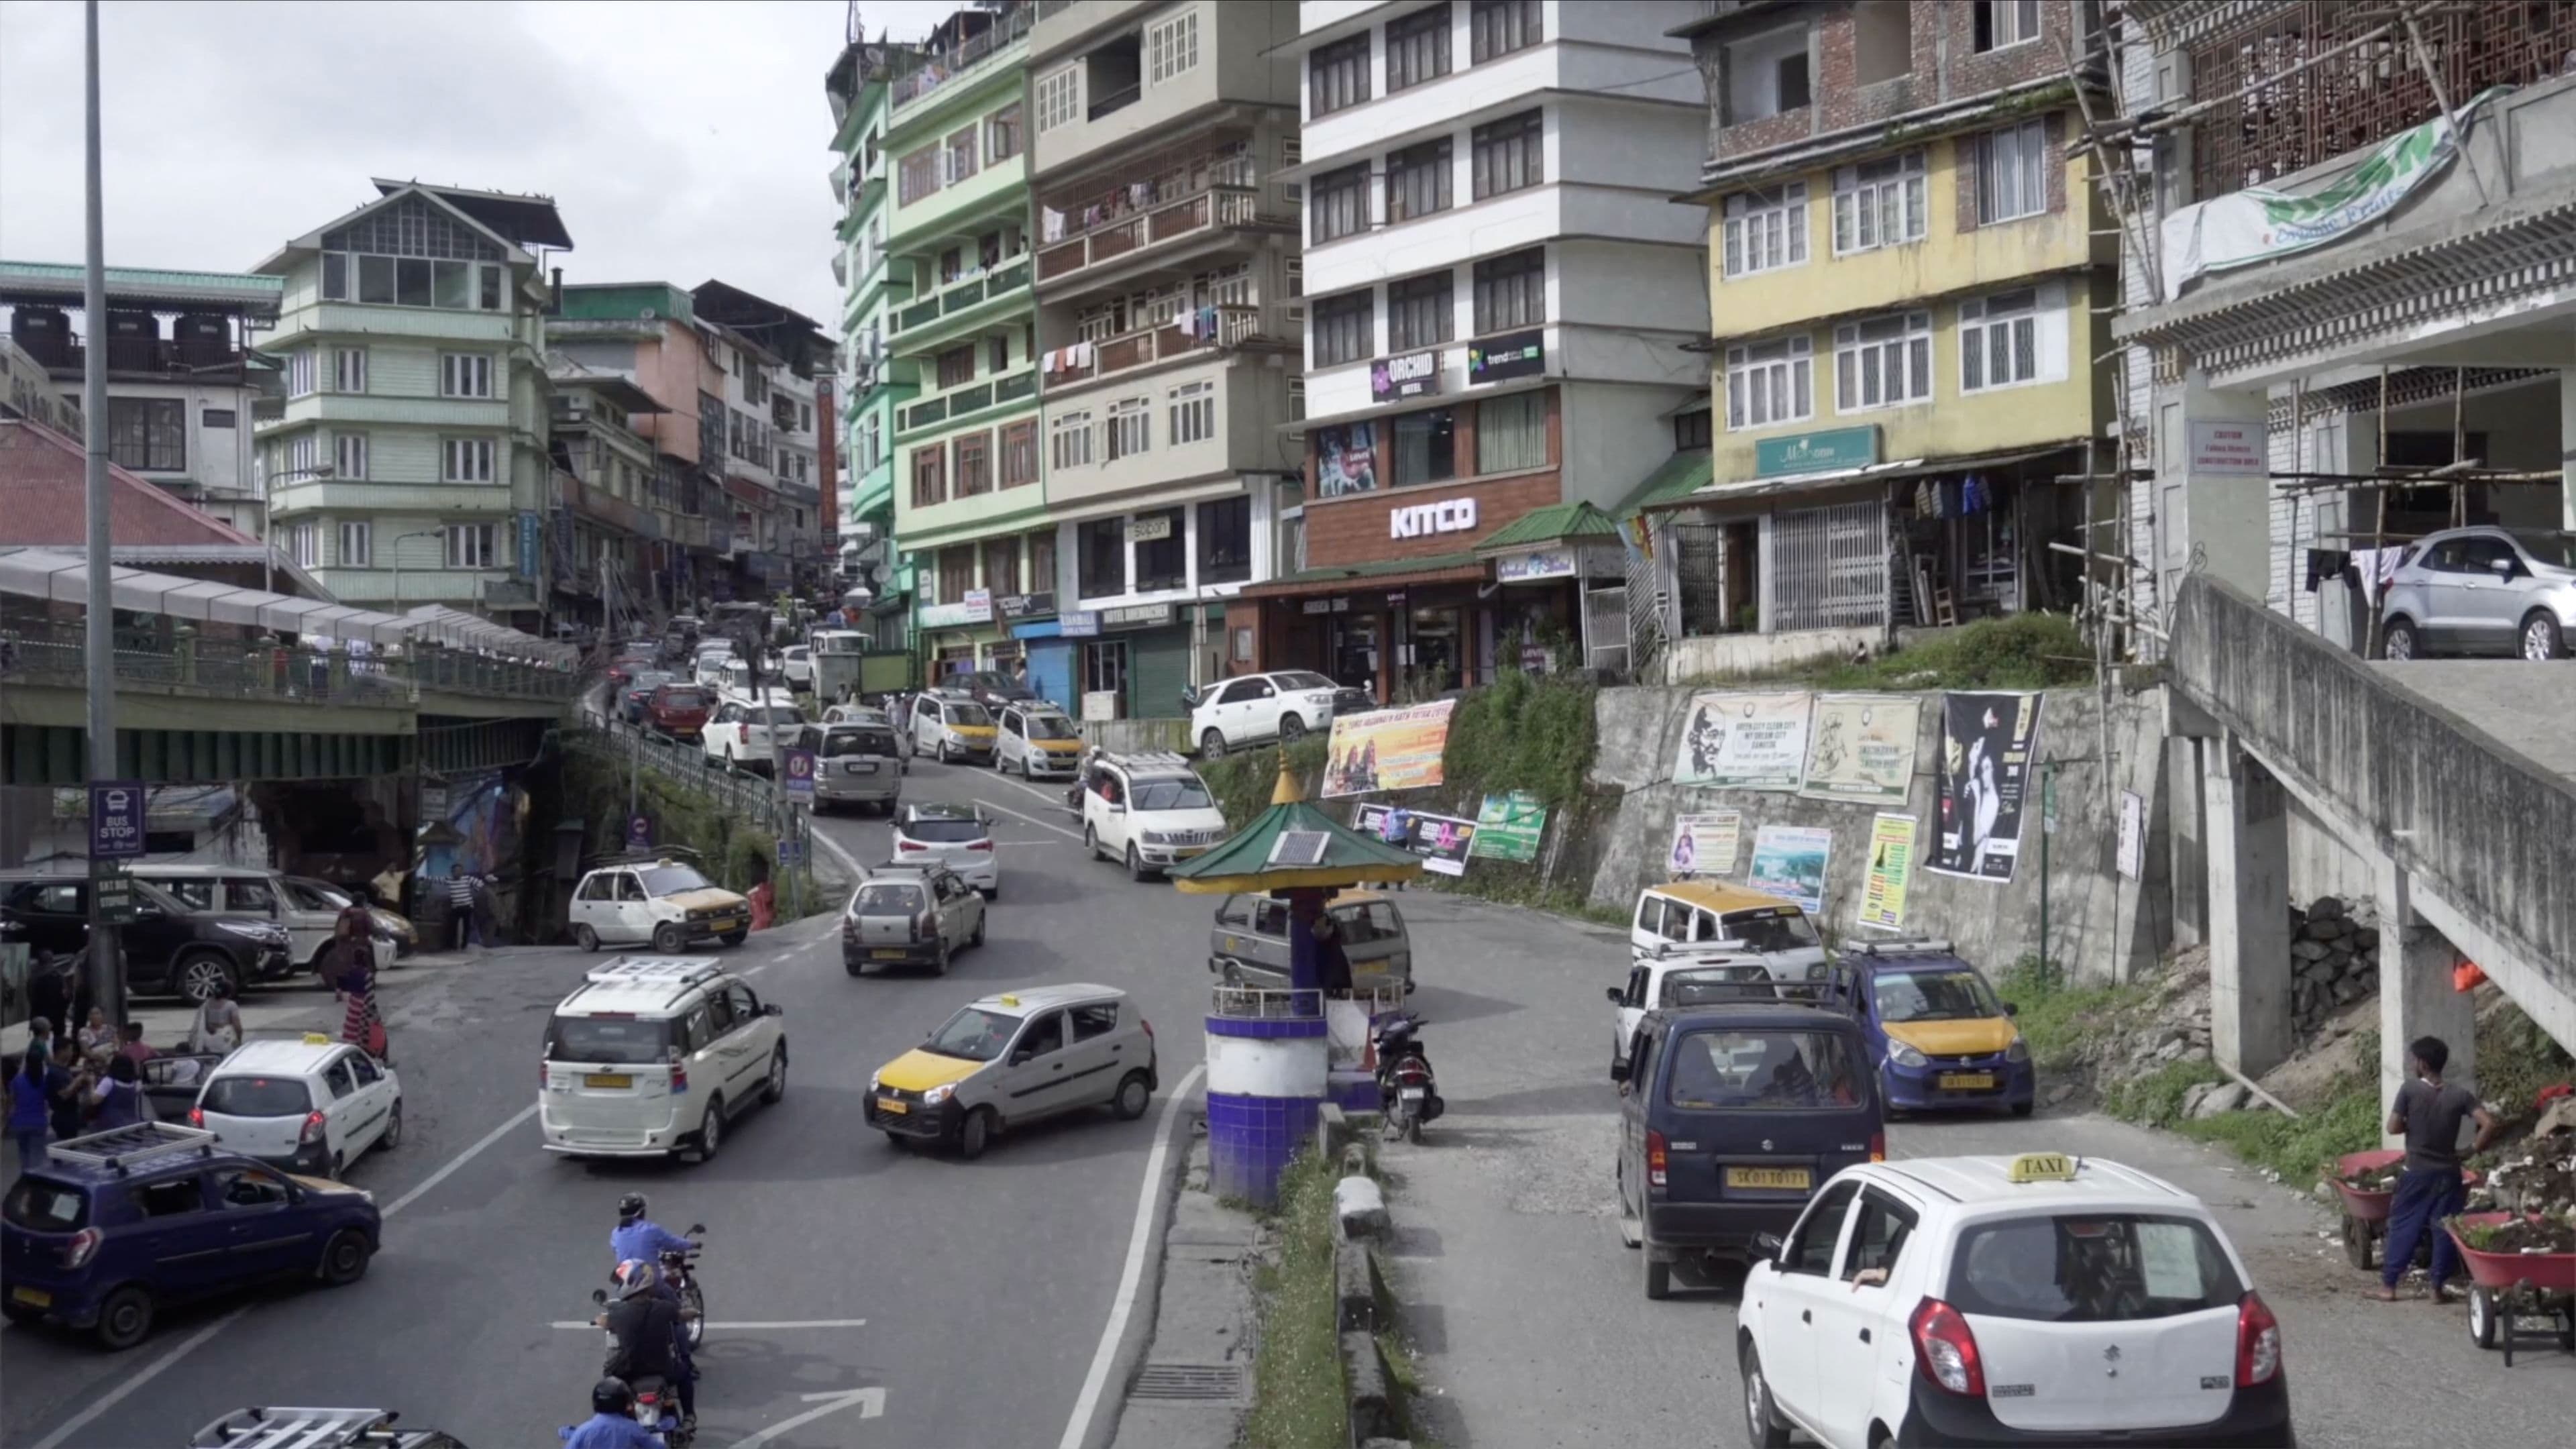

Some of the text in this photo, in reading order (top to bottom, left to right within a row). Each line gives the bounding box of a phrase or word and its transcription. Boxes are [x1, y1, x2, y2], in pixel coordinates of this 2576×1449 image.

[1389, 352, 1434, 382] ORCHID
[1401, 382, 1422, 395] HOTEL
[1391, 497, 1477, 539] KITCO
[106, 816, 128, 826] BUS
[100, 826, 136, 839] STOP
[2022, 1159, 2063, 1173] TAXI
